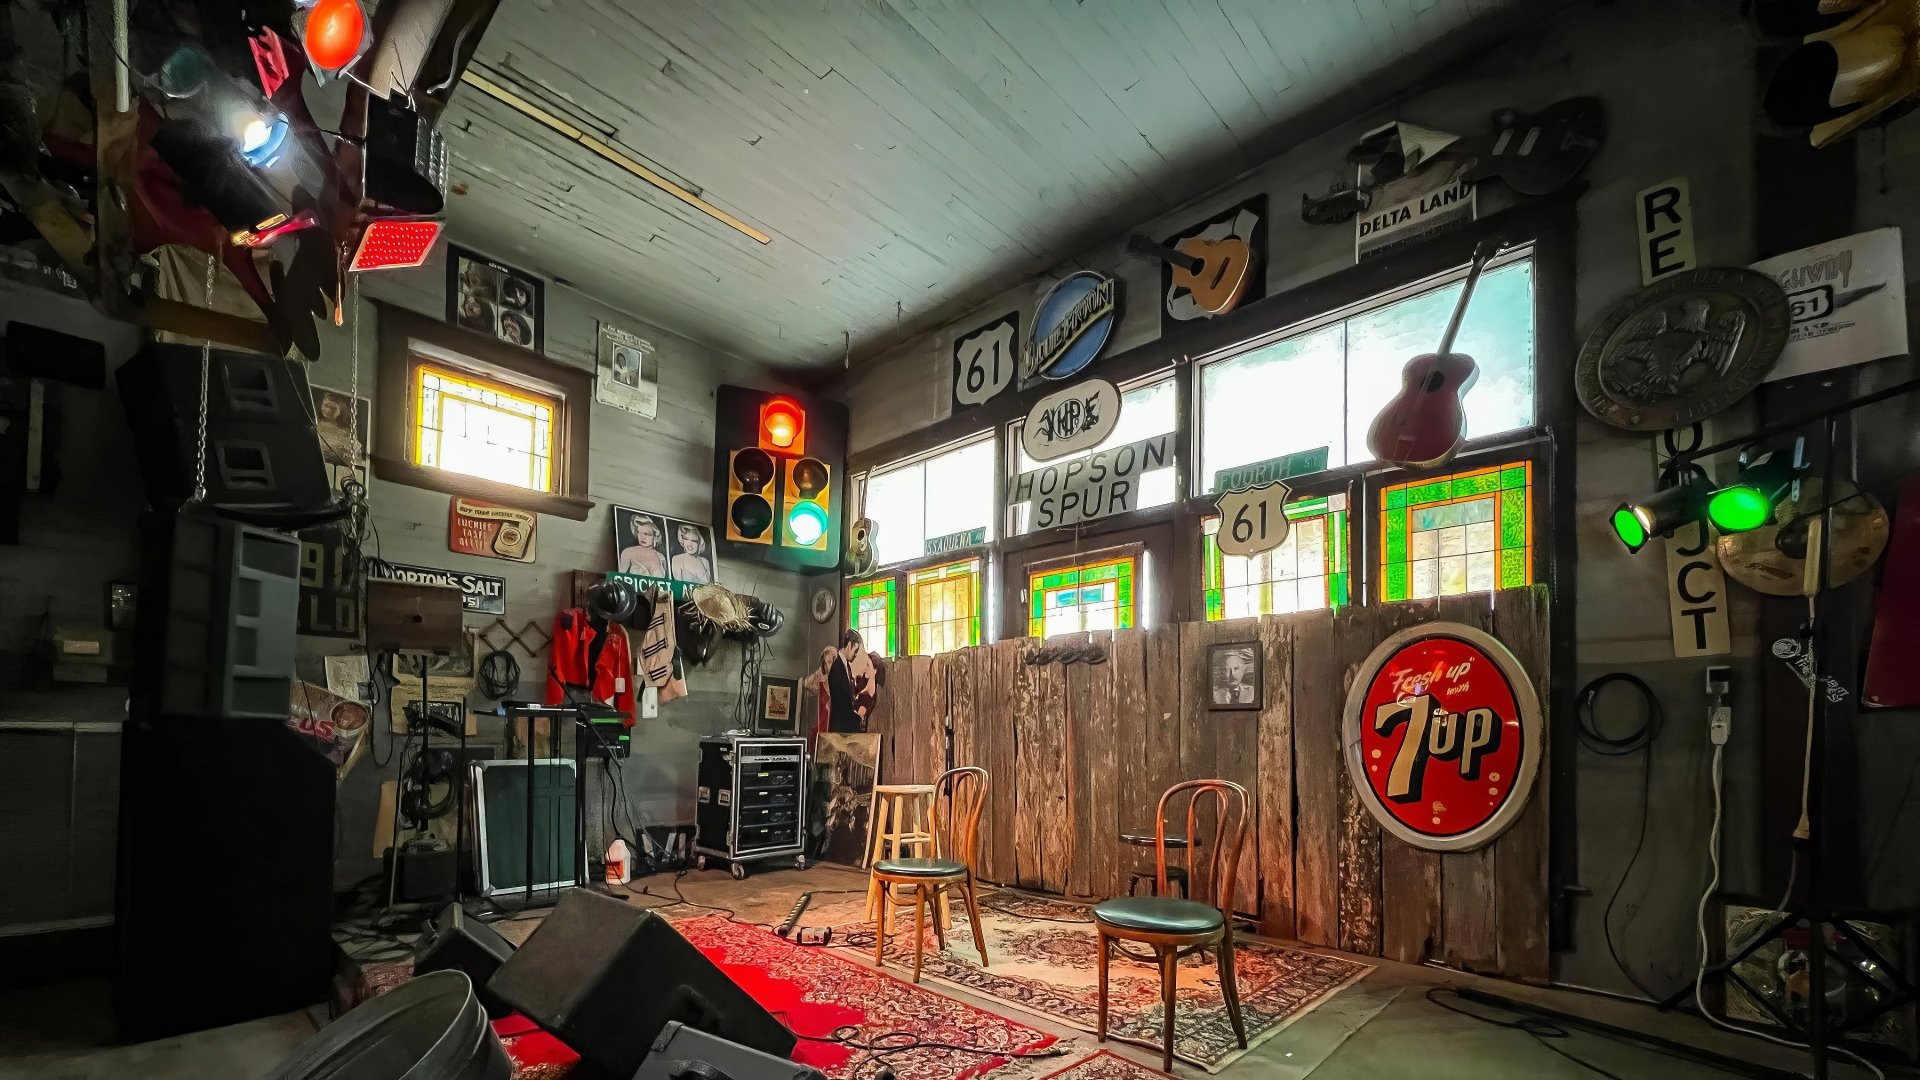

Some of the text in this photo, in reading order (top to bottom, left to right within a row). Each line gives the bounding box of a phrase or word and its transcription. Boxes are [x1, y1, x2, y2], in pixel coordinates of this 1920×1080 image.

[1359, 205, 1412, 238] DELTA
[1419, 182, 1474, 215] LAND
[1775, 250, 1853, 292] GHWAY
[1791, 296, 1819, 317] 61
[967, 339, 1001, 394] 61
[1016, 436, 1167, 503] HOPSON
[1220, 458, 1292, 492] FOURTH
[1038, 480, 1130, 528] SPUR
[1232, 500, 1267, 543] 61
[462, 575, 501, 597] SALT
